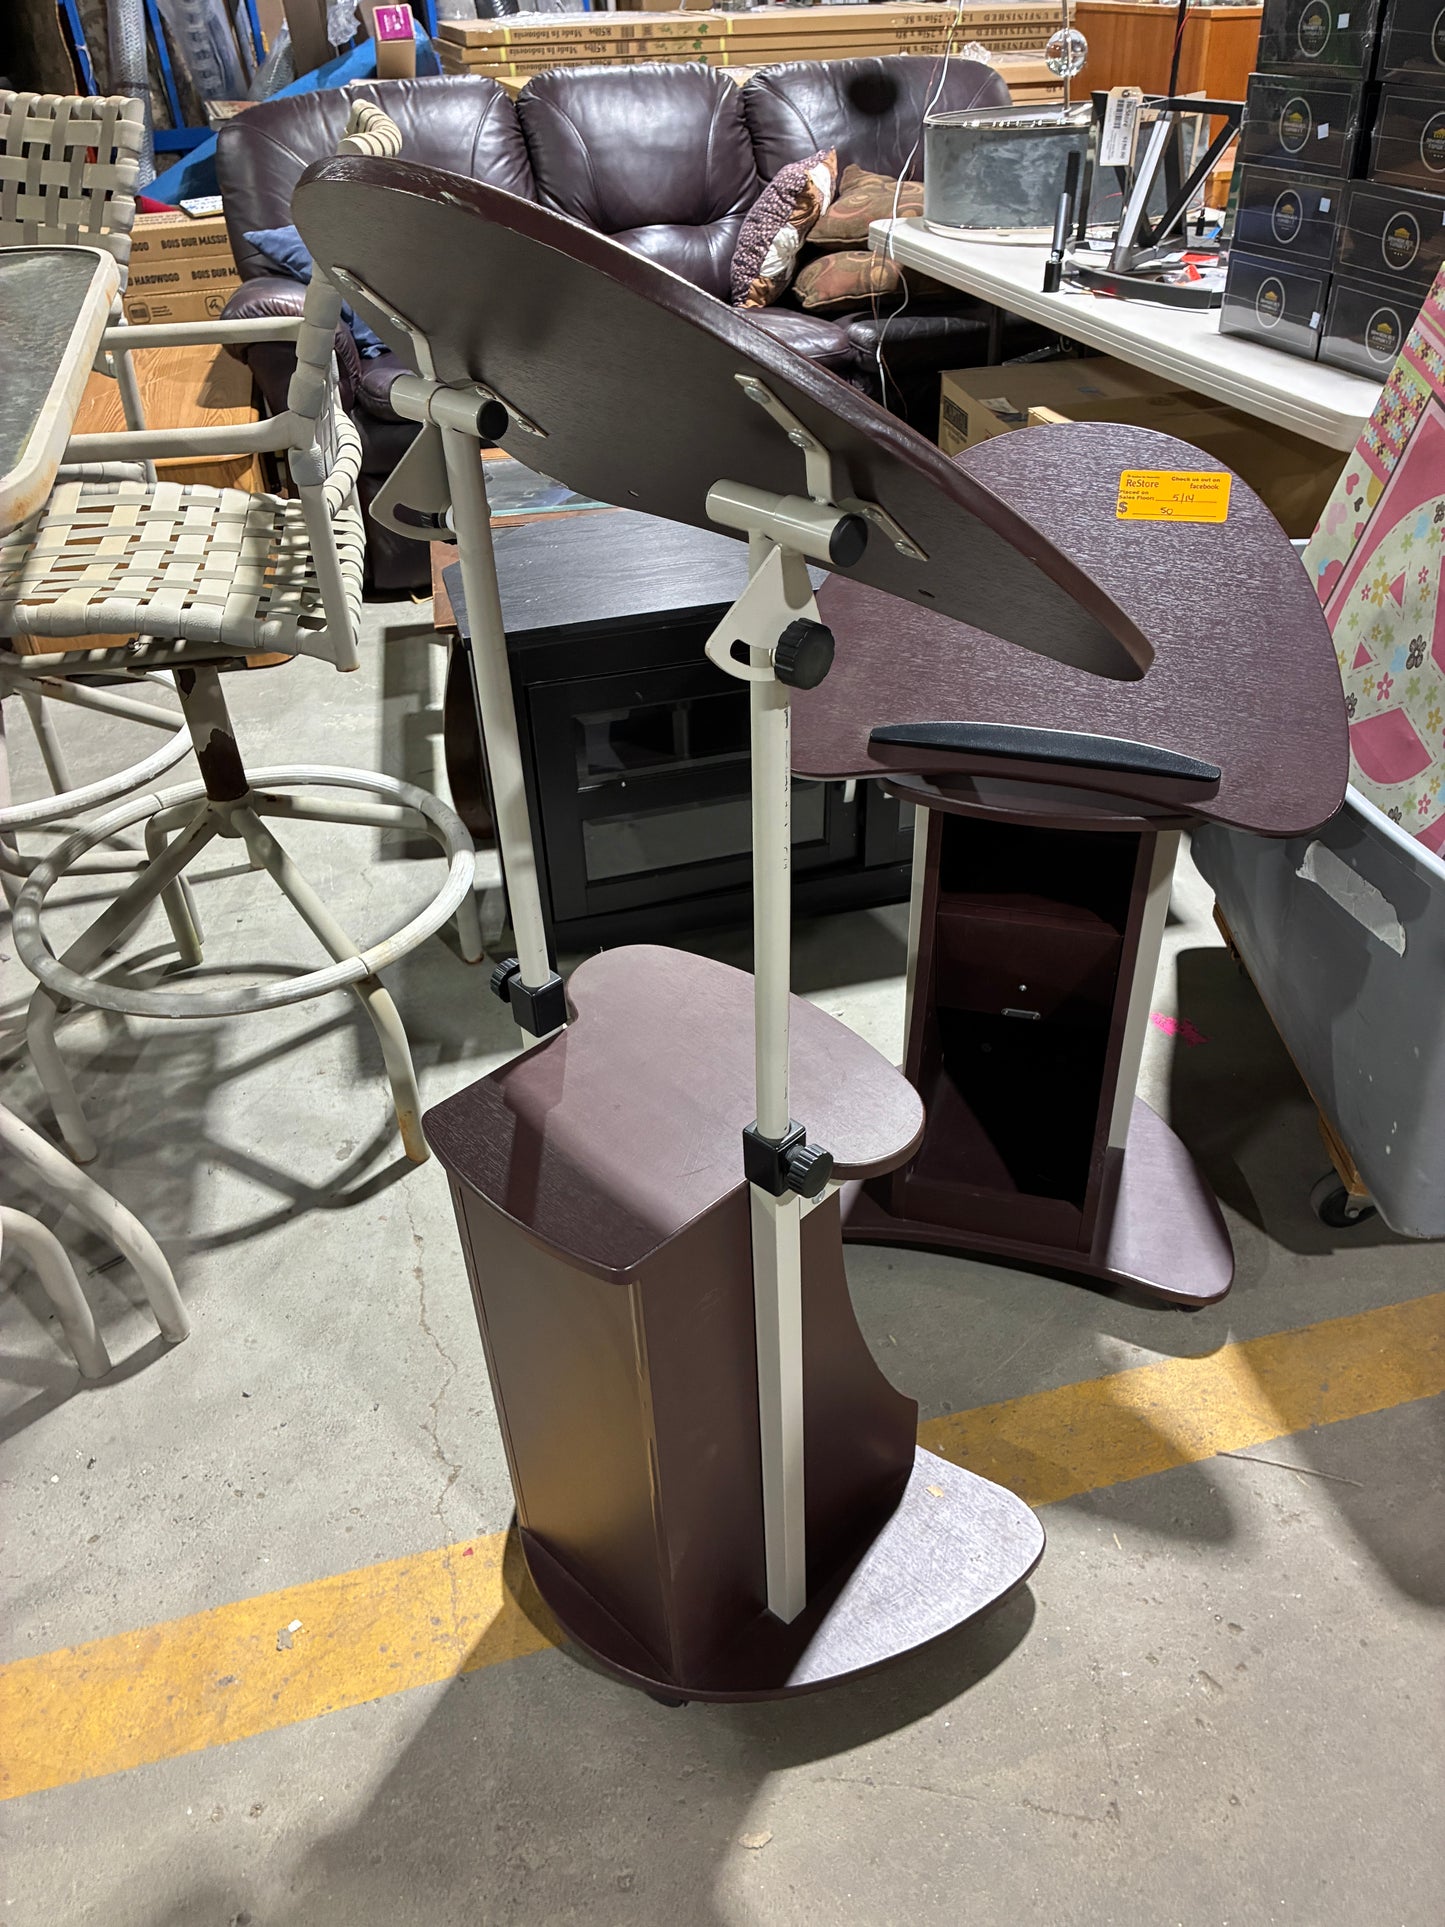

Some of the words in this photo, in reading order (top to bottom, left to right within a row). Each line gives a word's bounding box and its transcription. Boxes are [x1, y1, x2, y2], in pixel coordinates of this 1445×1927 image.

[514, 30, 549, 39] Indonesia
[562, 30, 583, 38] Made
[510, 47, 545, 55] Indonesia
[556, 45, 578, 55] Made
[161, 238, 180, 250] BOIS
[181, 237, 198, 247] DUR
[199, 234, 228, 246] MASSIF
[135, 272, 180, 286] HARDWOOD
[191, 269, 211, 280] BOIS
[211, 268, 228, 278] DUR
[1126, 479, 1159, 488] ReStore
[1118, 501, 1128, 515] $
